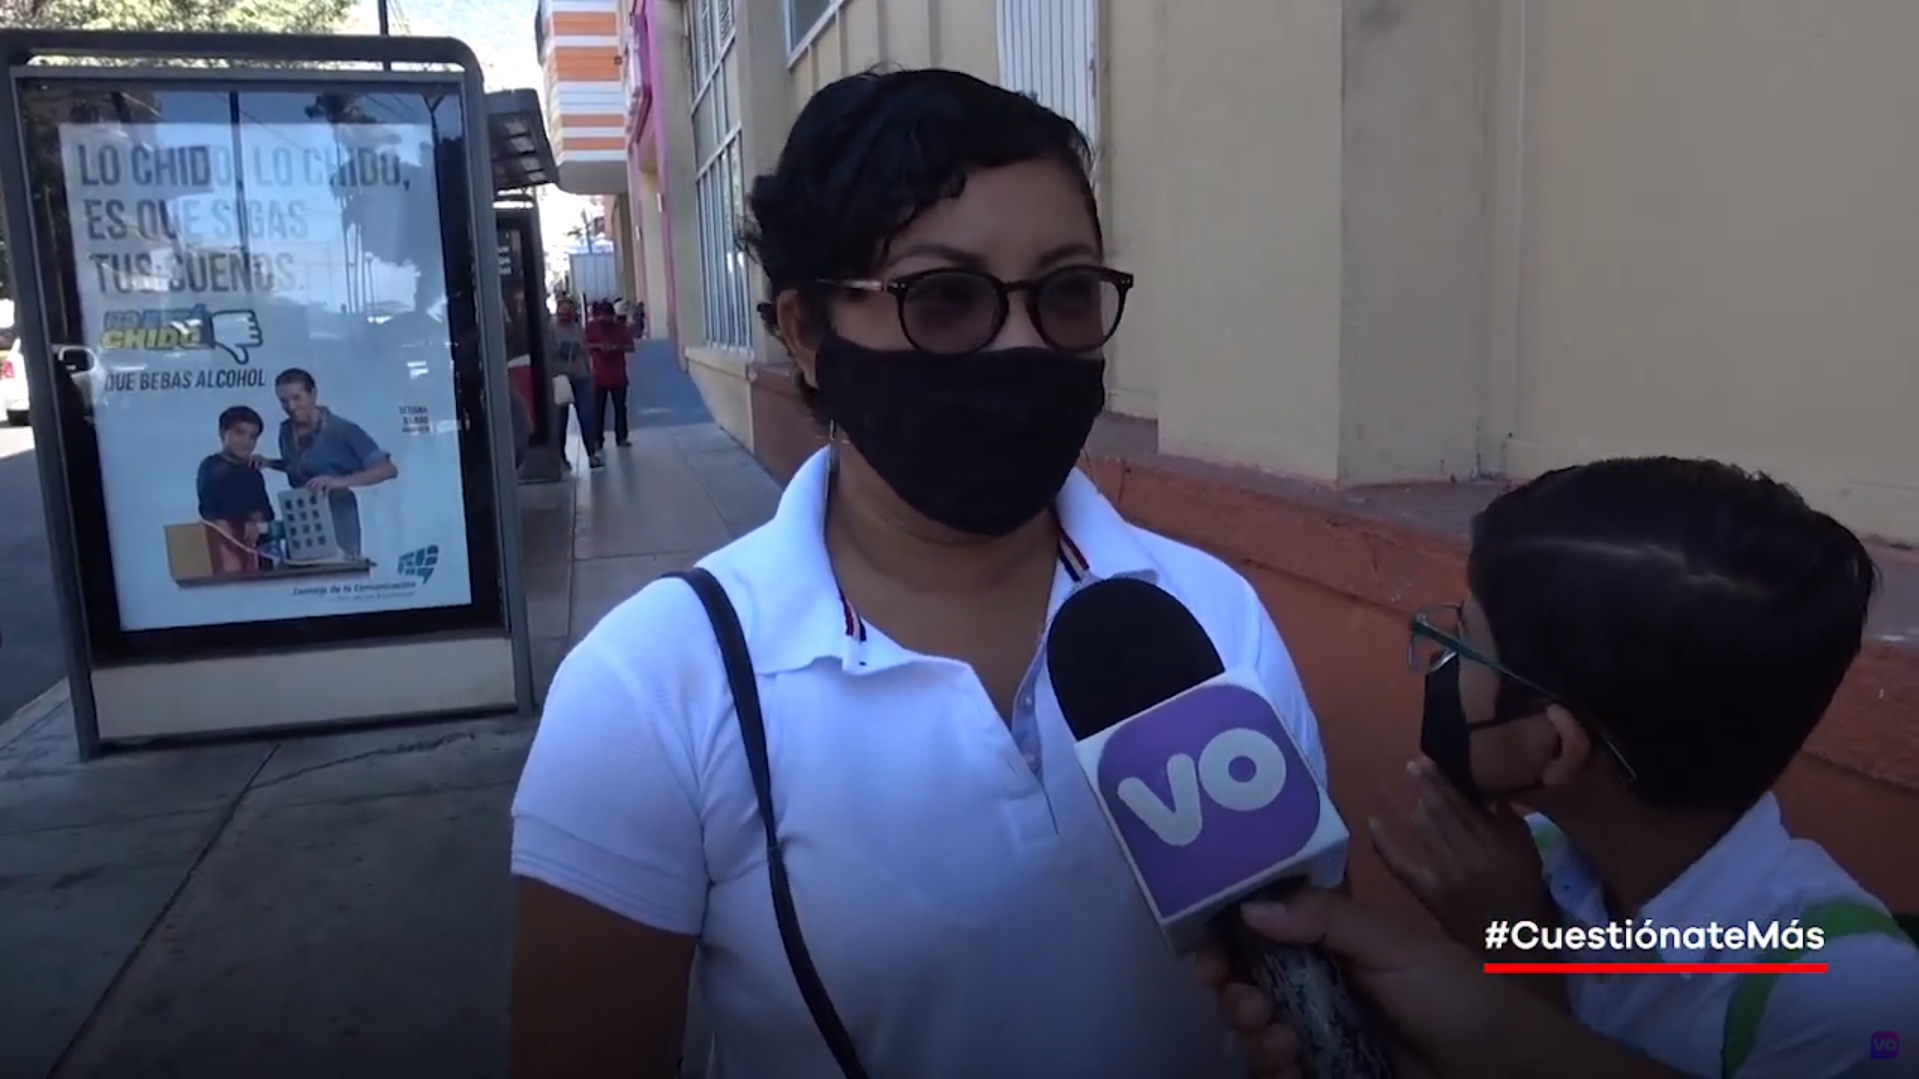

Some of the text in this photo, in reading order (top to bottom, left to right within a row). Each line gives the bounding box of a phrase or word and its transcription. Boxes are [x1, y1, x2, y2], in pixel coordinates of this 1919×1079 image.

[78, 144, 121, 186] LO
[253, 145, 294, 187] LO
[84, 199, 127, 240] ES
[105, 367, 265, 391] QUE BEBAS ALCOHOL
